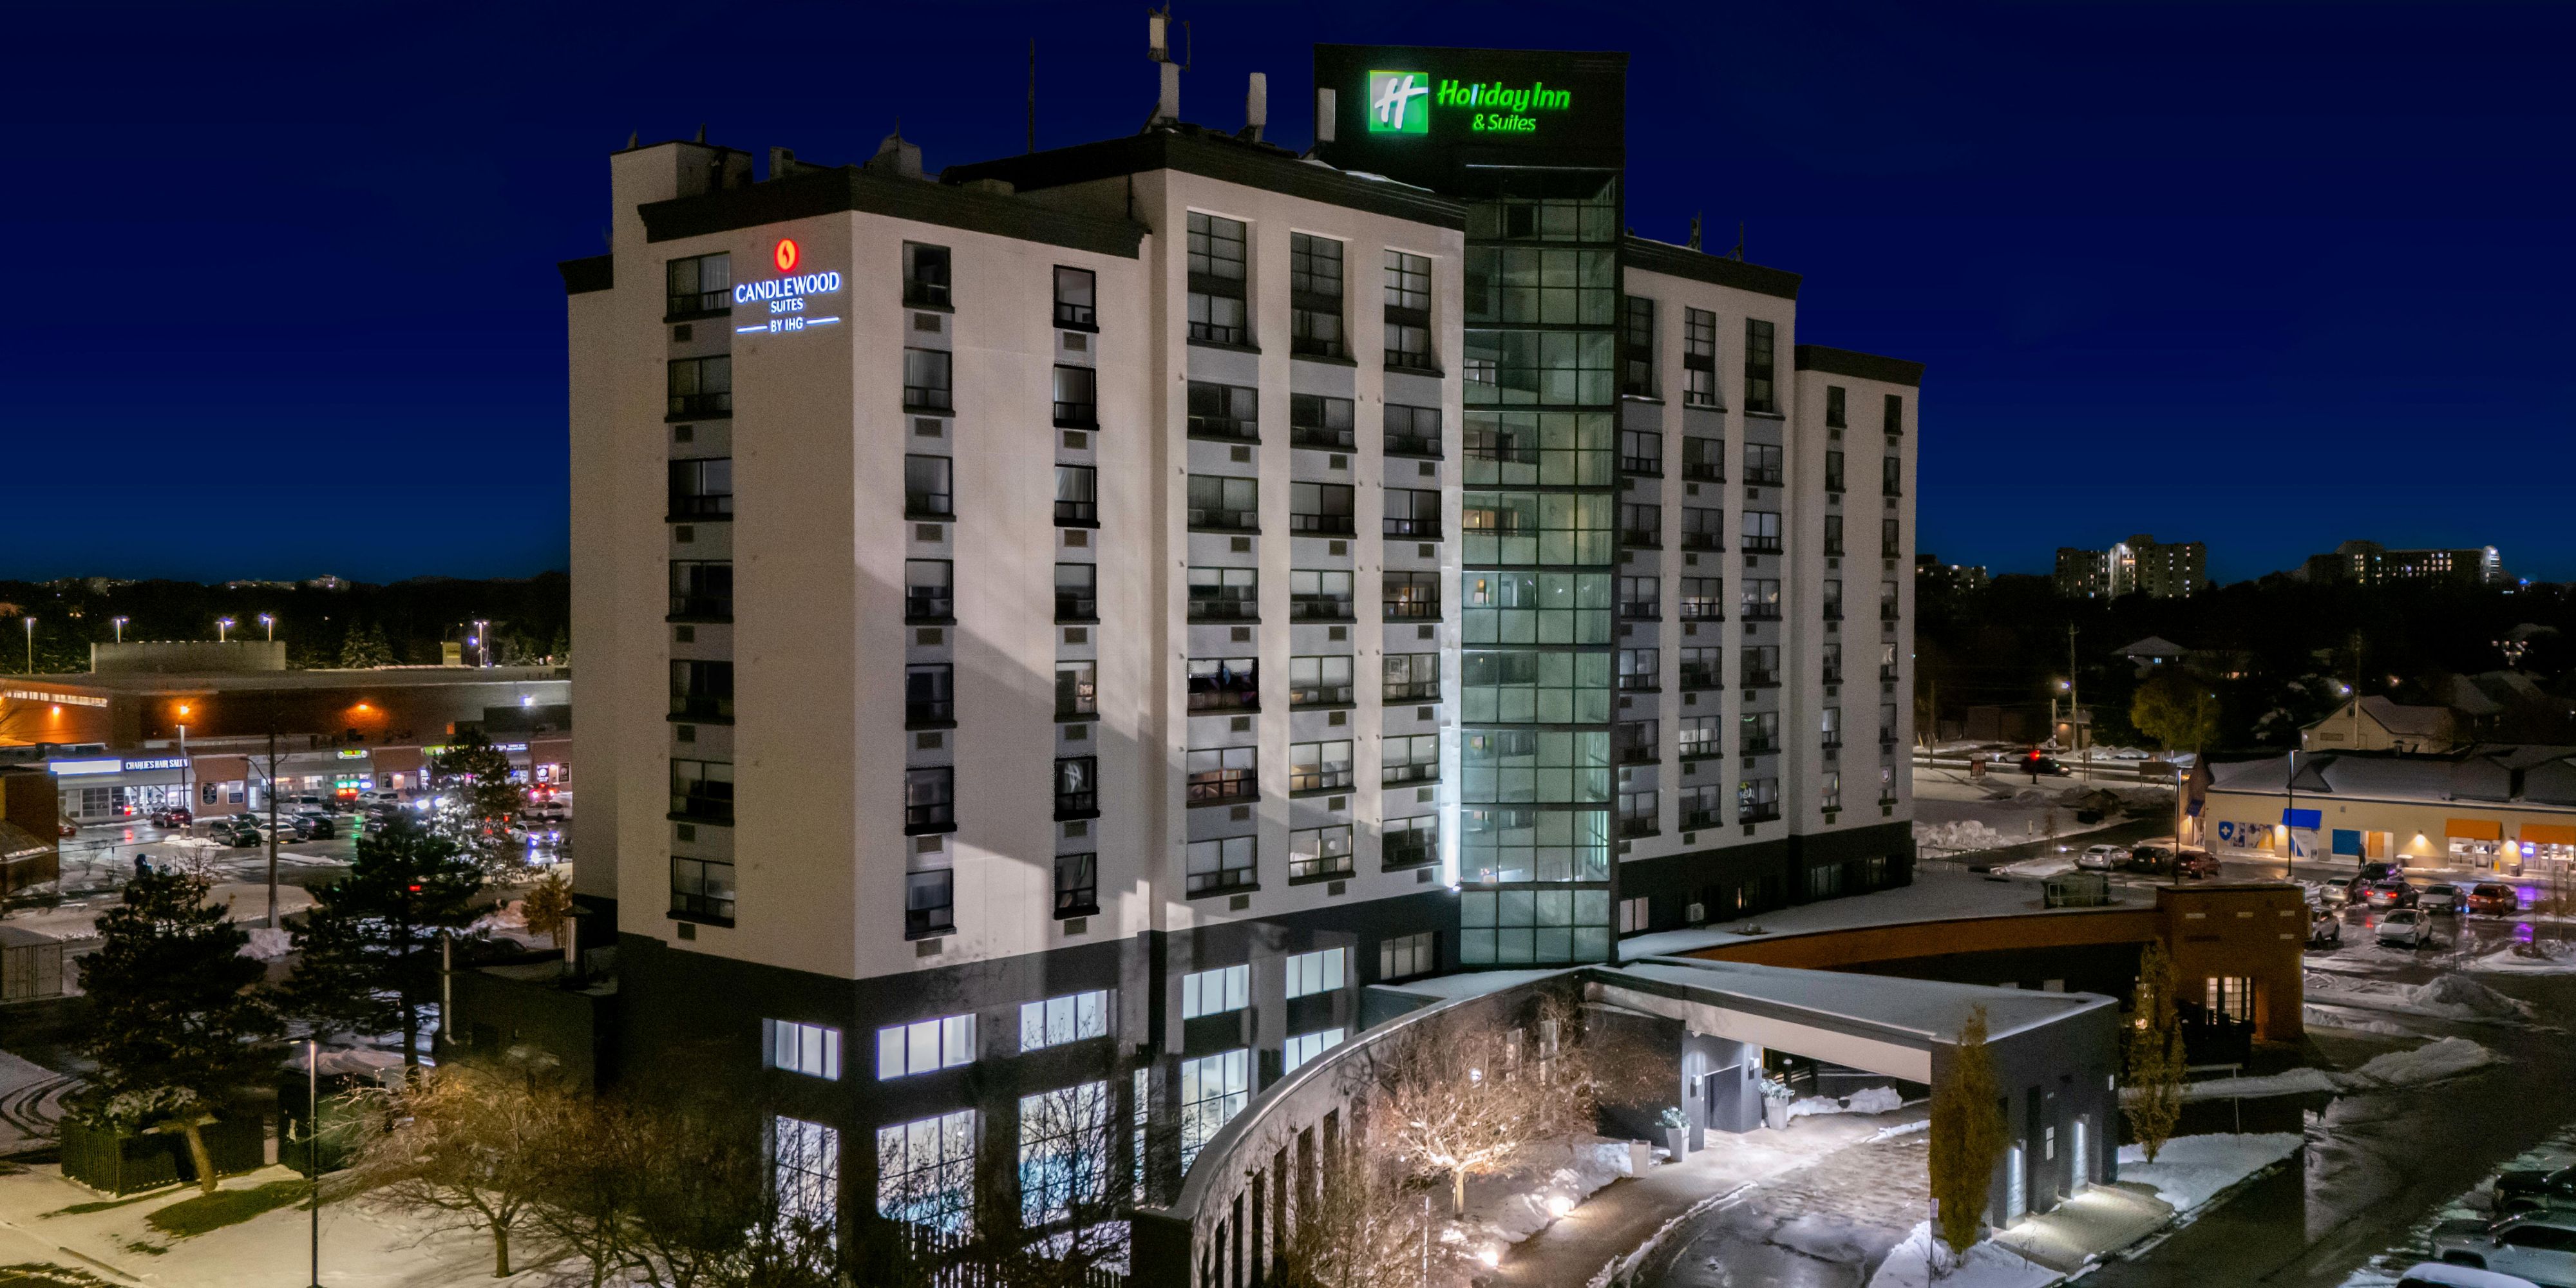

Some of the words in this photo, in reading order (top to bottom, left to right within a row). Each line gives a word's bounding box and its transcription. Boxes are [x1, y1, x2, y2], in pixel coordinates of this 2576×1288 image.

[1437, 80, 1530, 111] Holiday
[1533, 82, 1570, 108] Inn
[1473, 114, 1485, 130] &
[1488, 115, 1536, 130] Suites
[735, 272, 840, 303] CANDLEWOOD
[771, 298, 804, 312] SUITES
[771, 319, 782, 332] BY
[785, 317, 804, 330] IHG
[155, 760, 169, 769] HAIR
